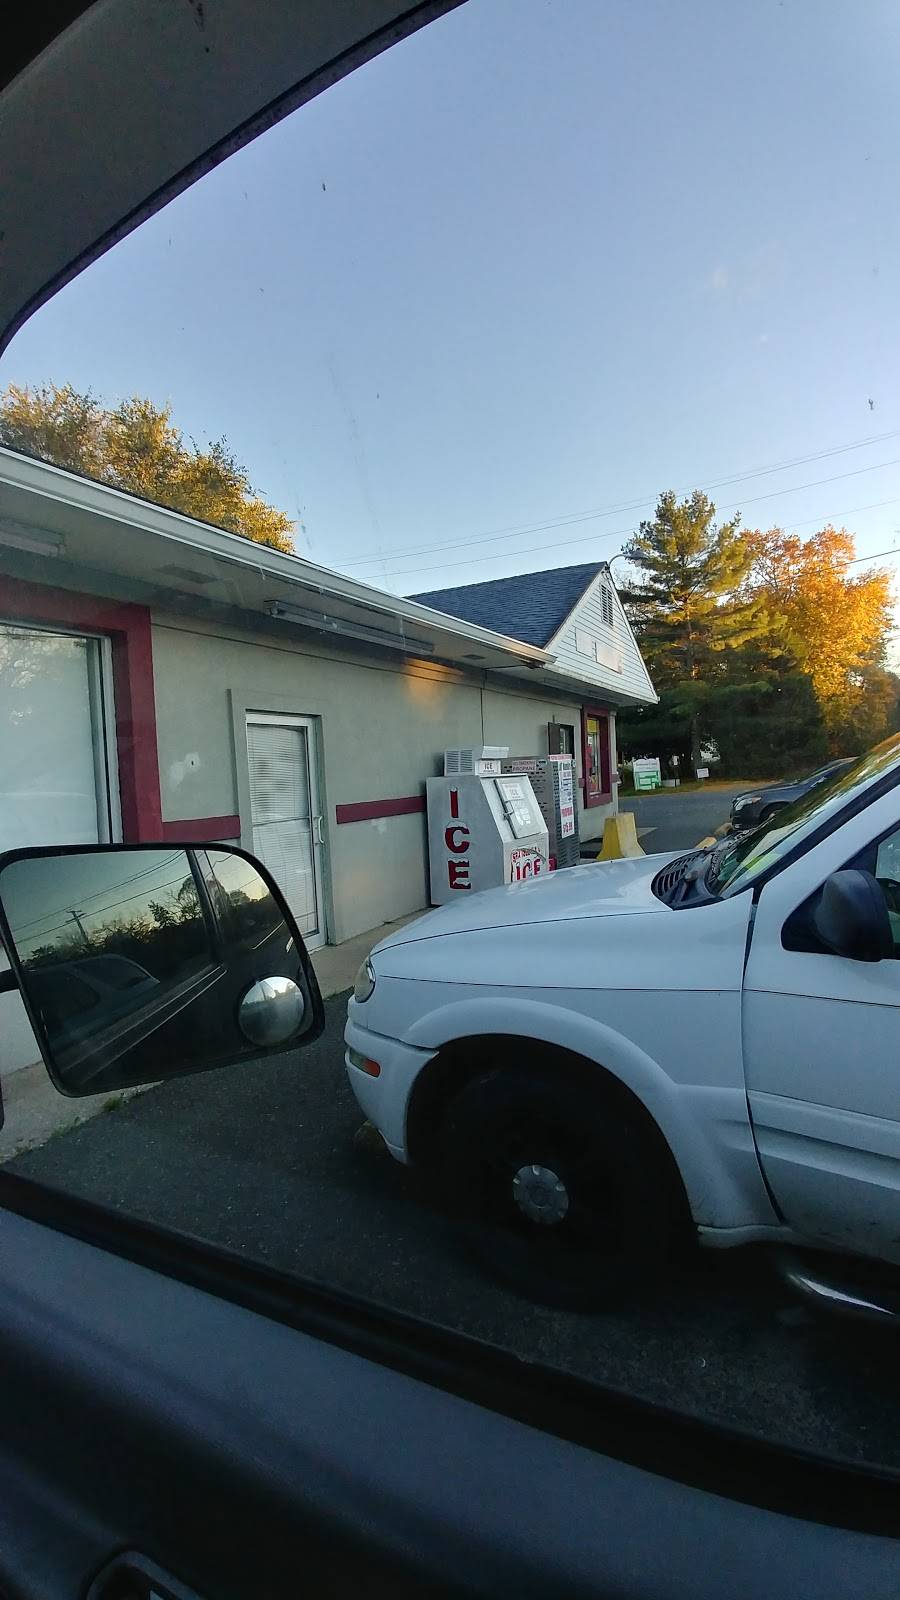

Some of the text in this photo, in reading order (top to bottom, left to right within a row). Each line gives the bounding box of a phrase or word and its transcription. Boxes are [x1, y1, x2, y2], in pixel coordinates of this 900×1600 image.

[484, 762, 493, 770] ICE
[444, 787, 471, 890] ICE
[515, 857, 541, 881] ICE
